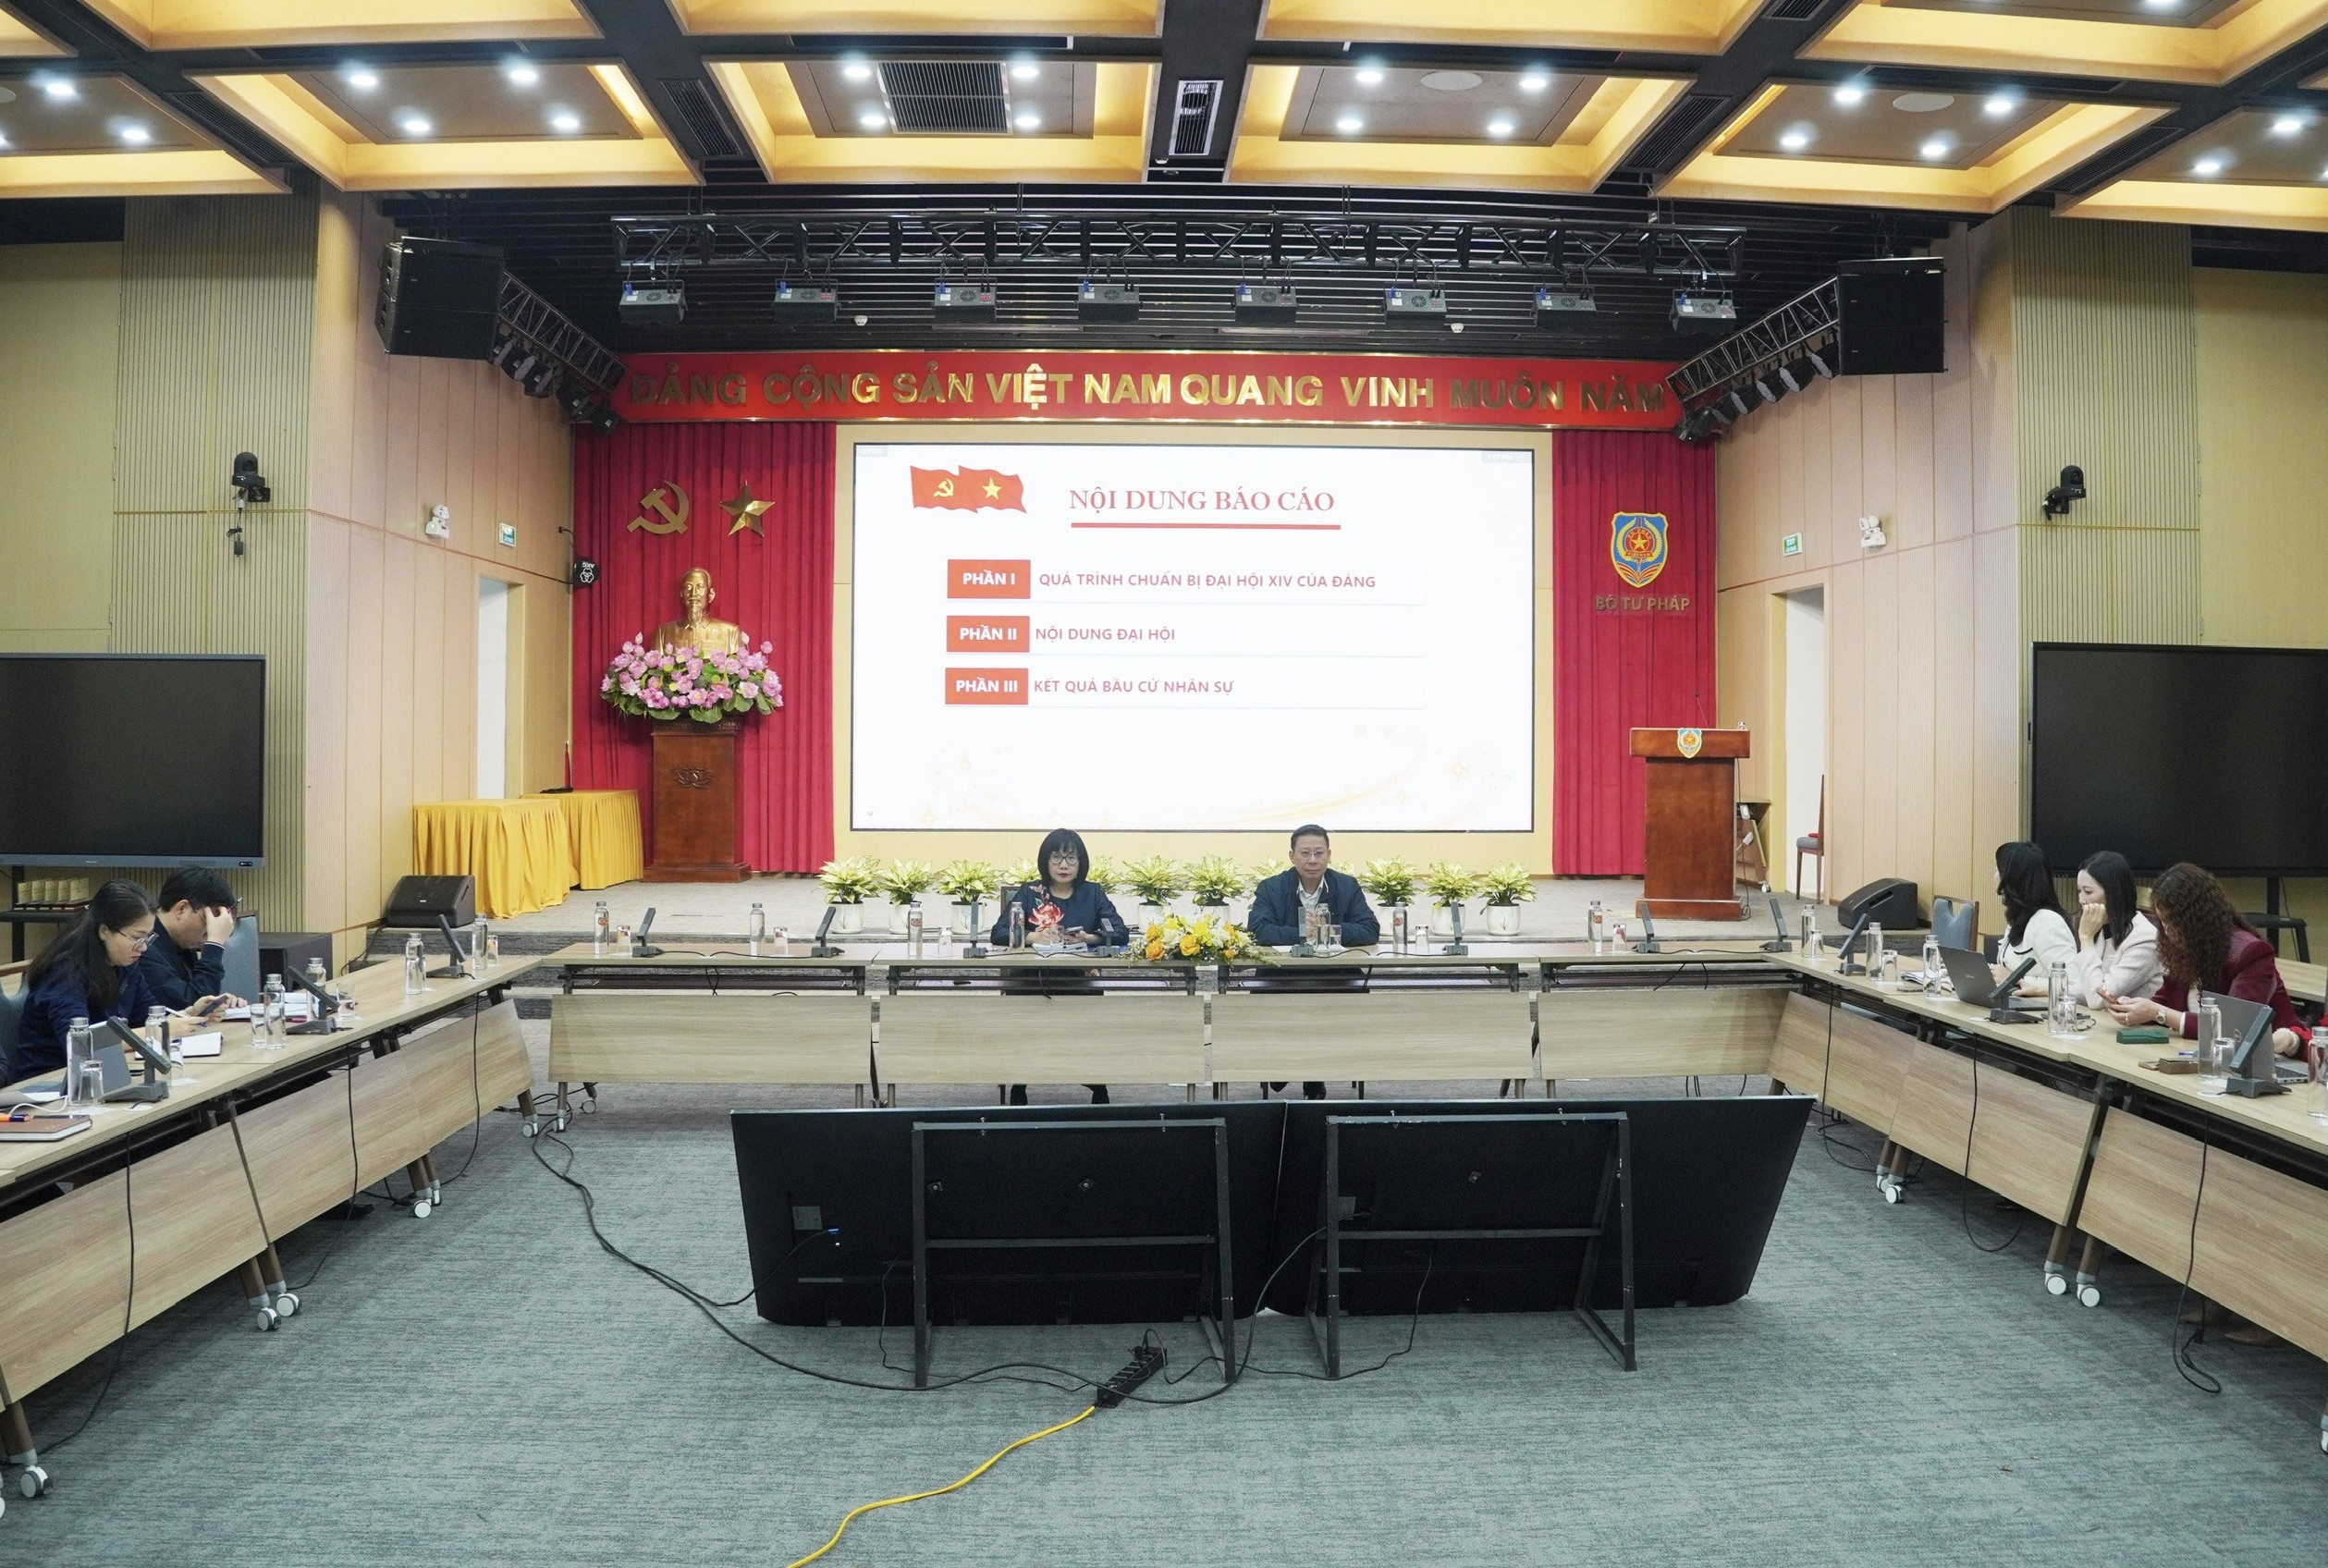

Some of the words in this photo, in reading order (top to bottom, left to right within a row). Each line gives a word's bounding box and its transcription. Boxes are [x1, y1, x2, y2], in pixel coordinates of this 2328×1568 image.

[631, 361, 747, 405] ĐẢNG
[763, 364, 880, 410] CỘNG
[892, 361, 974, 404] SẢN
[986, 363, 1073, 410] VIỆT
[1084, 374, 1171, 405] NAM
[1180, 374, 1323, 407] QUANG
[1341, 375, 1434, 408] VINH
[1451, 372, 1564, 410] MUÔN
[1581, 374, 1664, 412] NĂM
[1069, 486, 1117, 514] NỘI
[1125, 490, 1207, 510] DUNG
[1215, 485, 1271, 511] BÁO
[1278, 486, 1335, 511] CÁO
[962, 569, 1006, 585] PHẦN
[1011, 572, 1016, 585] I
[1039, 570, 1072, 587] QUÁ
[1077, 570, 1123, 586] TRÌNH
[1187, 574, 1201, 589] BỊ
[1206, 574, 1231, 589] ĐẠI
[1237, 572, 1264, 590] HỘI
[1268, 575, 1293, 587] XIV
[1297, 572, 1328, 588] CỦA
[1332, 572, 1376, 588] ĐẢNG
[1595, 595, 1618, 614] BỘ
[1622, 595, 1645, 611] TƯ
[1647, 594, 1690, 611] PHÁP
[960, 624, 1003, 640] PHẦN
[1008, 627, 1017, 640] II
[1035, 626, 1063, 643] NỘI
[1068, 628, 1112, 641] DUNG
[1117, 628, 1143, 643] ĐẠI
[1148, 626, 1175, 643] HỘI
[956, 677, 999, 692] PHẦN
[1004, 680, 1018, 692] III
[1164, 679, 1209, 693] NHÂN
[1214, 680, 1234, 696] SỰ
